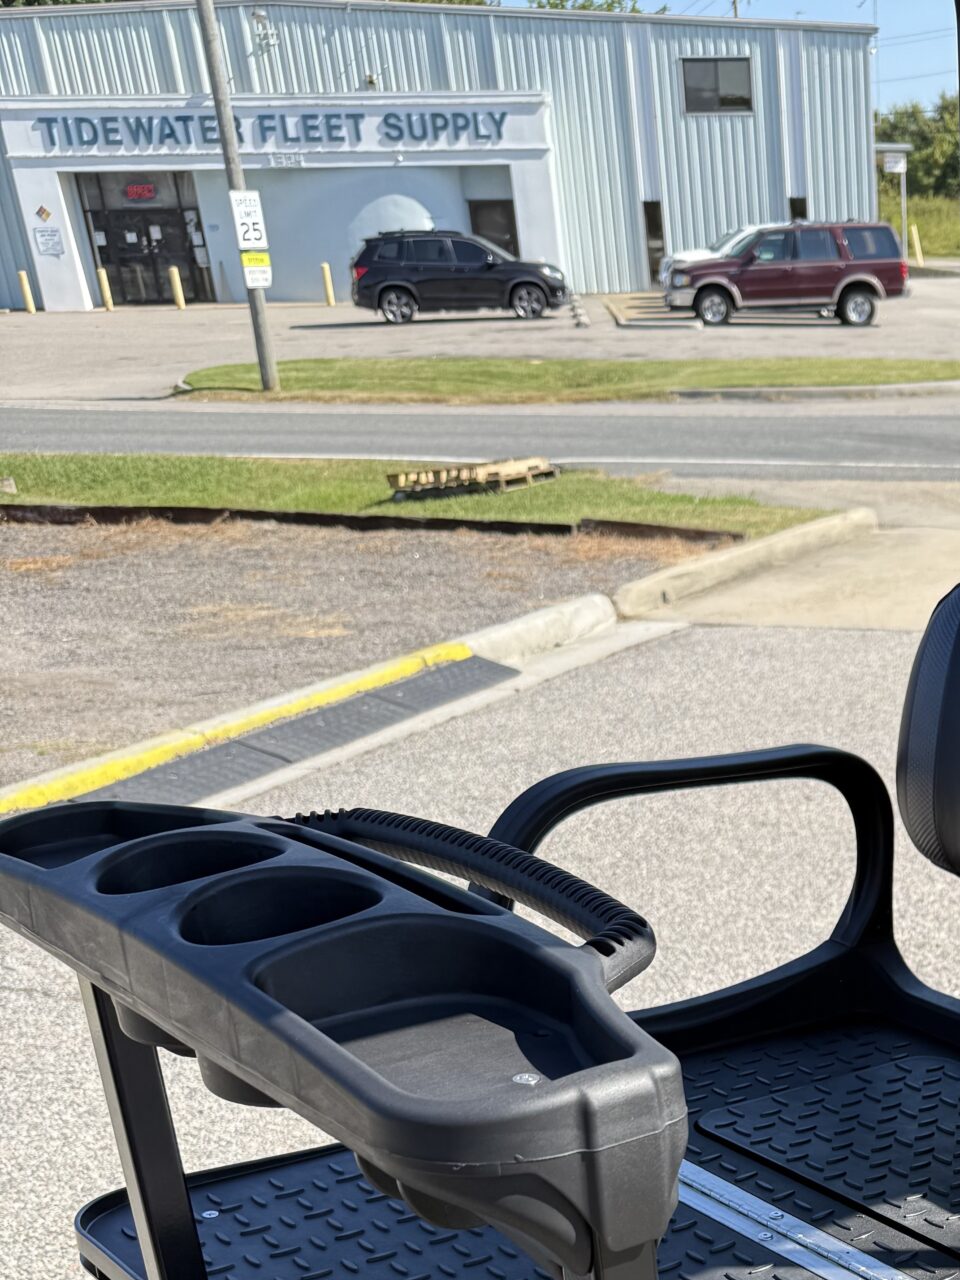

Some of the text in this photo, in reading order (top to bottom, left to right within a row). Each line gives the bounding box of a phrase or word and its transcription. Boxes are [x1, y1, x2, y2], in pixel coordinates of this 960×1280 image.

[257, 113, 365, 143] FLEET
[383, 111, 508, 141] SUPPLY
[240, 222, 263, 241] 25
